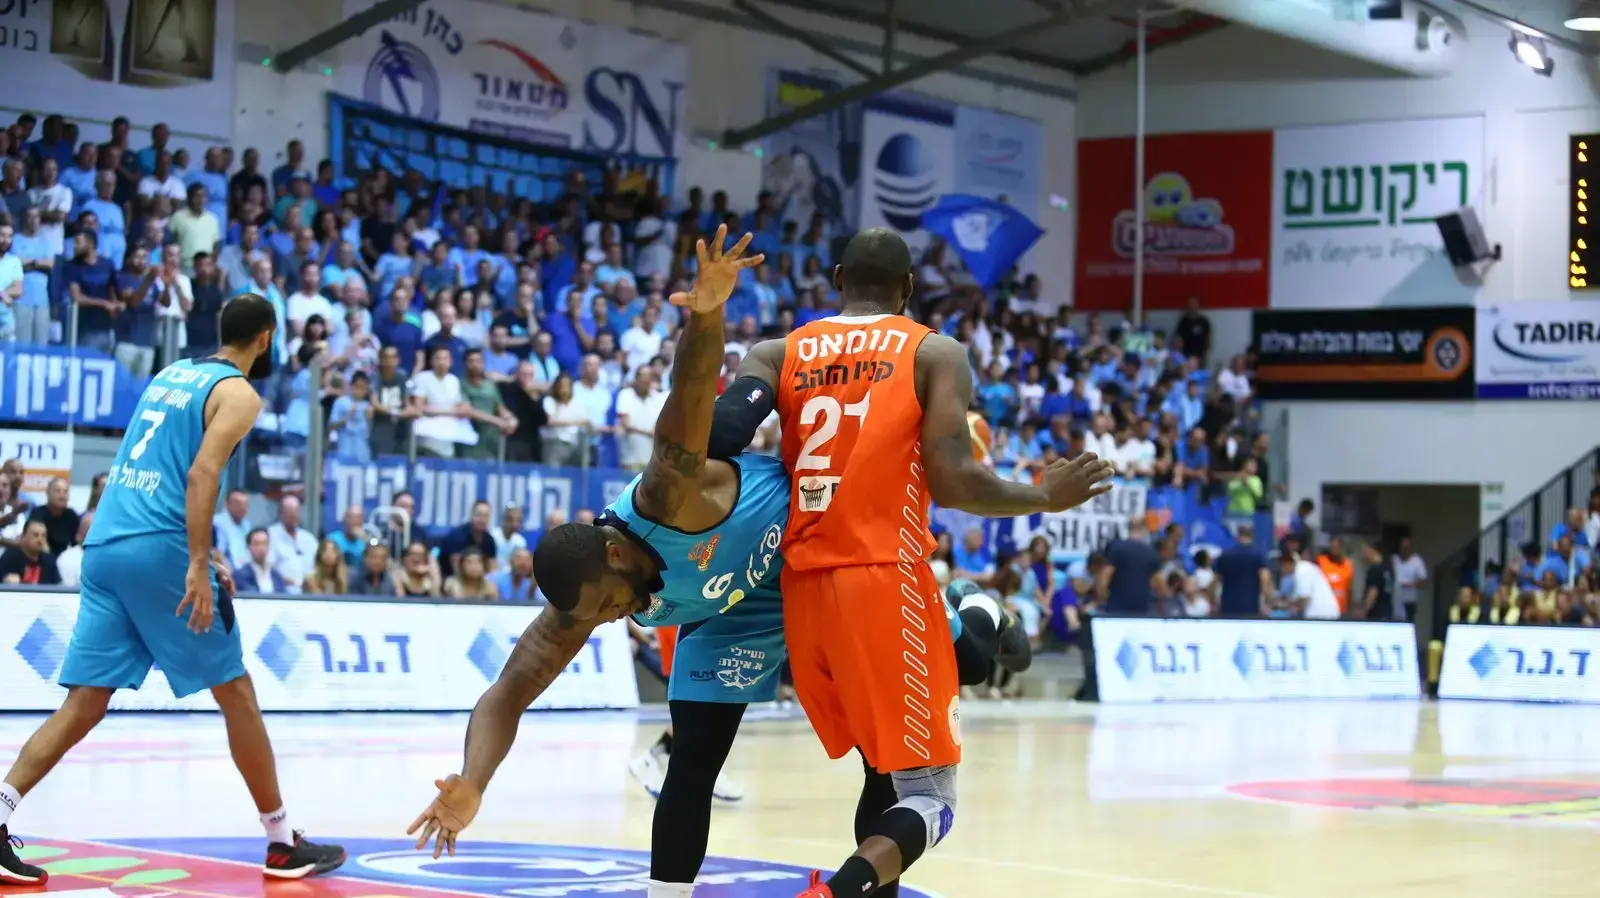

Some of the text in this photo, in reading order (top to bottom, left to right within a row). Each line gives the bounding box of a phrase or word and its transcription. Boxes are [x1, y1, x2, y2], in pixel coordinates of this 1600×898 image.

[584, 66, 685, 158] SN
[1283, 161, 1469, 226] ריקושט
[794, 360, 895, 392] קניון הזהב
[797, 329, 910, 363] תומאס
[15, 353, 116, 422] קניון
[130, 408, 166, 461] 7
[414, 462, 478, 528] מול
